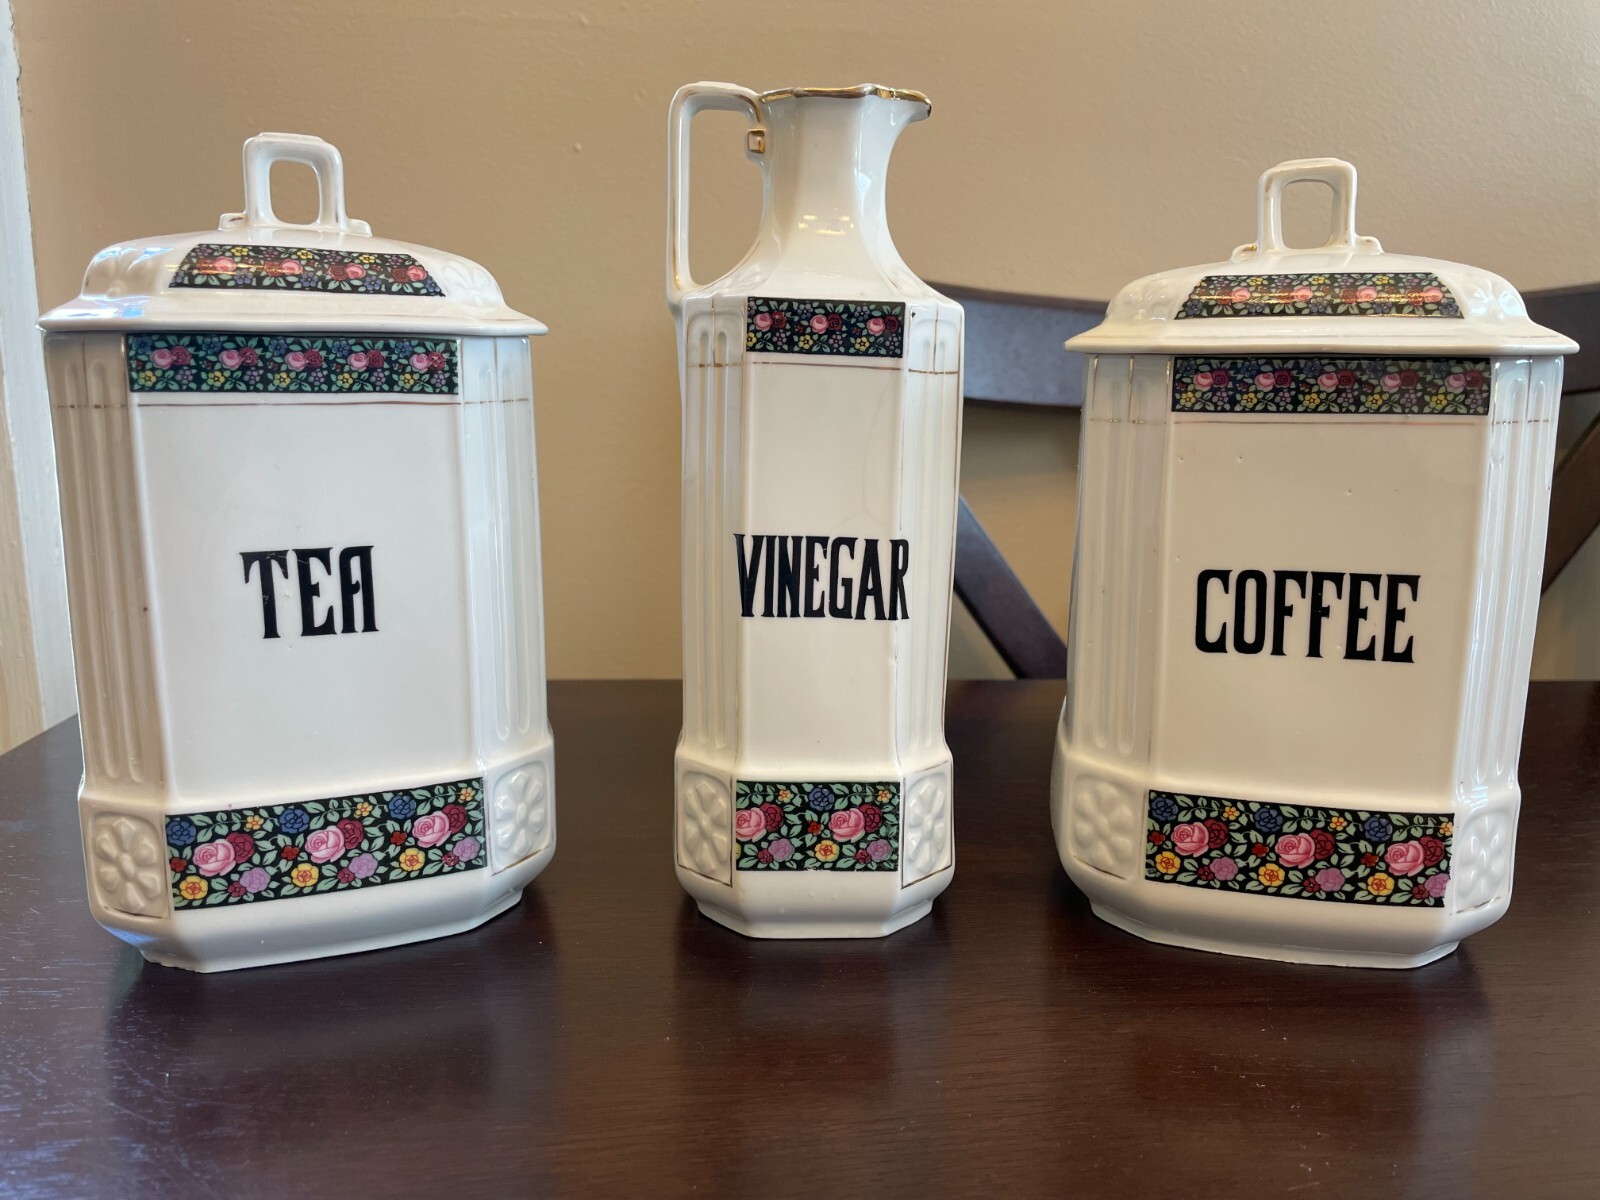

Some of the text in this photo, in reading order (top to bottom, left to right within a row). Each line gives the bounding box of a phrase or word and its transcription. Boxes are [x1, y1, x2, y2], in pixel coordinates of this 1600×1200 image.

[240, 546, 379, 639] TEA
[733, 533, 910, 621] VINEGAR
[1195, 569, 1421, 663] COFFEE
